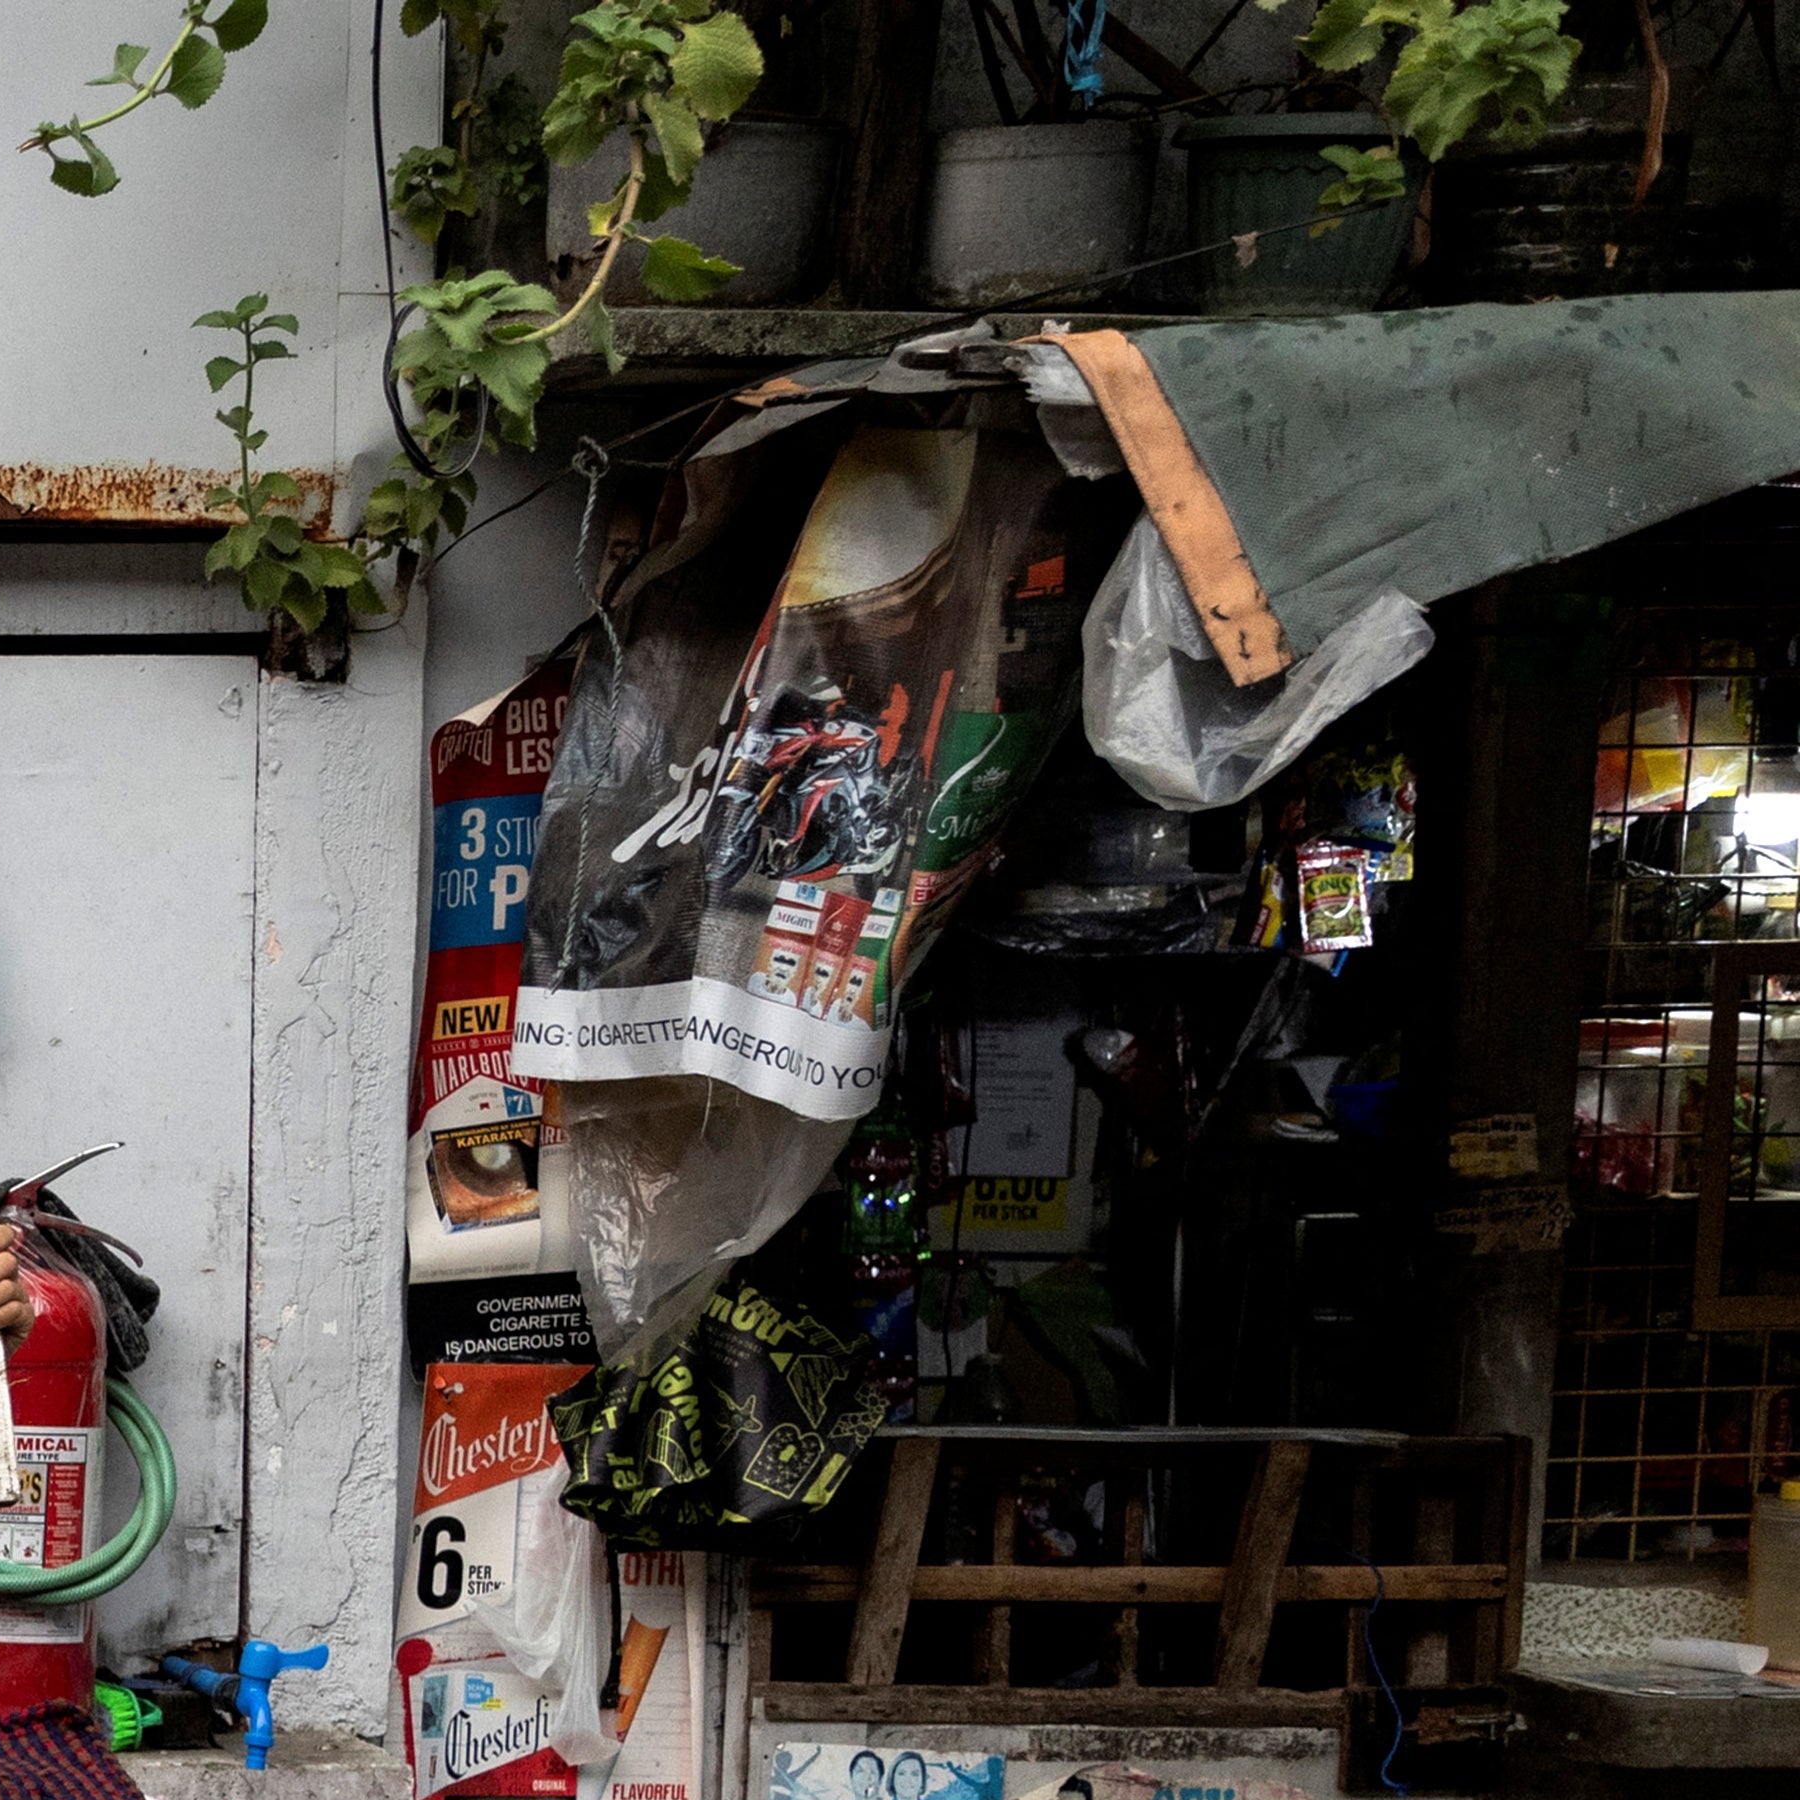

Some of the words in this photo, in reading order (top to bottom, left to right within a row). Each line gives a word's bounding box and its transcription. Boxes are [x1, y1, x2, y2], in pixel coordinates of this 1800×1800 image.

[505, 698, 547, 735] BIG
[437, 727, 493, 775] CRAFTED
[459, 807, 487, 860] 3
[437, 868, 478, 911] FOR
[441, 1003, 501, 1036] NEW
[576, 1015, 685, 1049] CIGARETTE
[802, 1054, 825, 1086] TO
[457, 1129, 523, 1145] KATARATA
[972, 1206, 997, 1220] PER
[1001, 1205, 1038, 1220] STICK
[489, 1312, 581, 1333] CIGARETTE
[445, 1340, 462, 1356] IS
[464, 1334, 564, 1356] DANGEROUS
[568, 1331, 590, 1346] TO
[17, 1438, 77, 1451] MICAL
[37, 1453, 60, 1461] TYPE
[468, 1565, 492, 1579] PER
[532, 1780, 567, 1791] ORIGINAL
